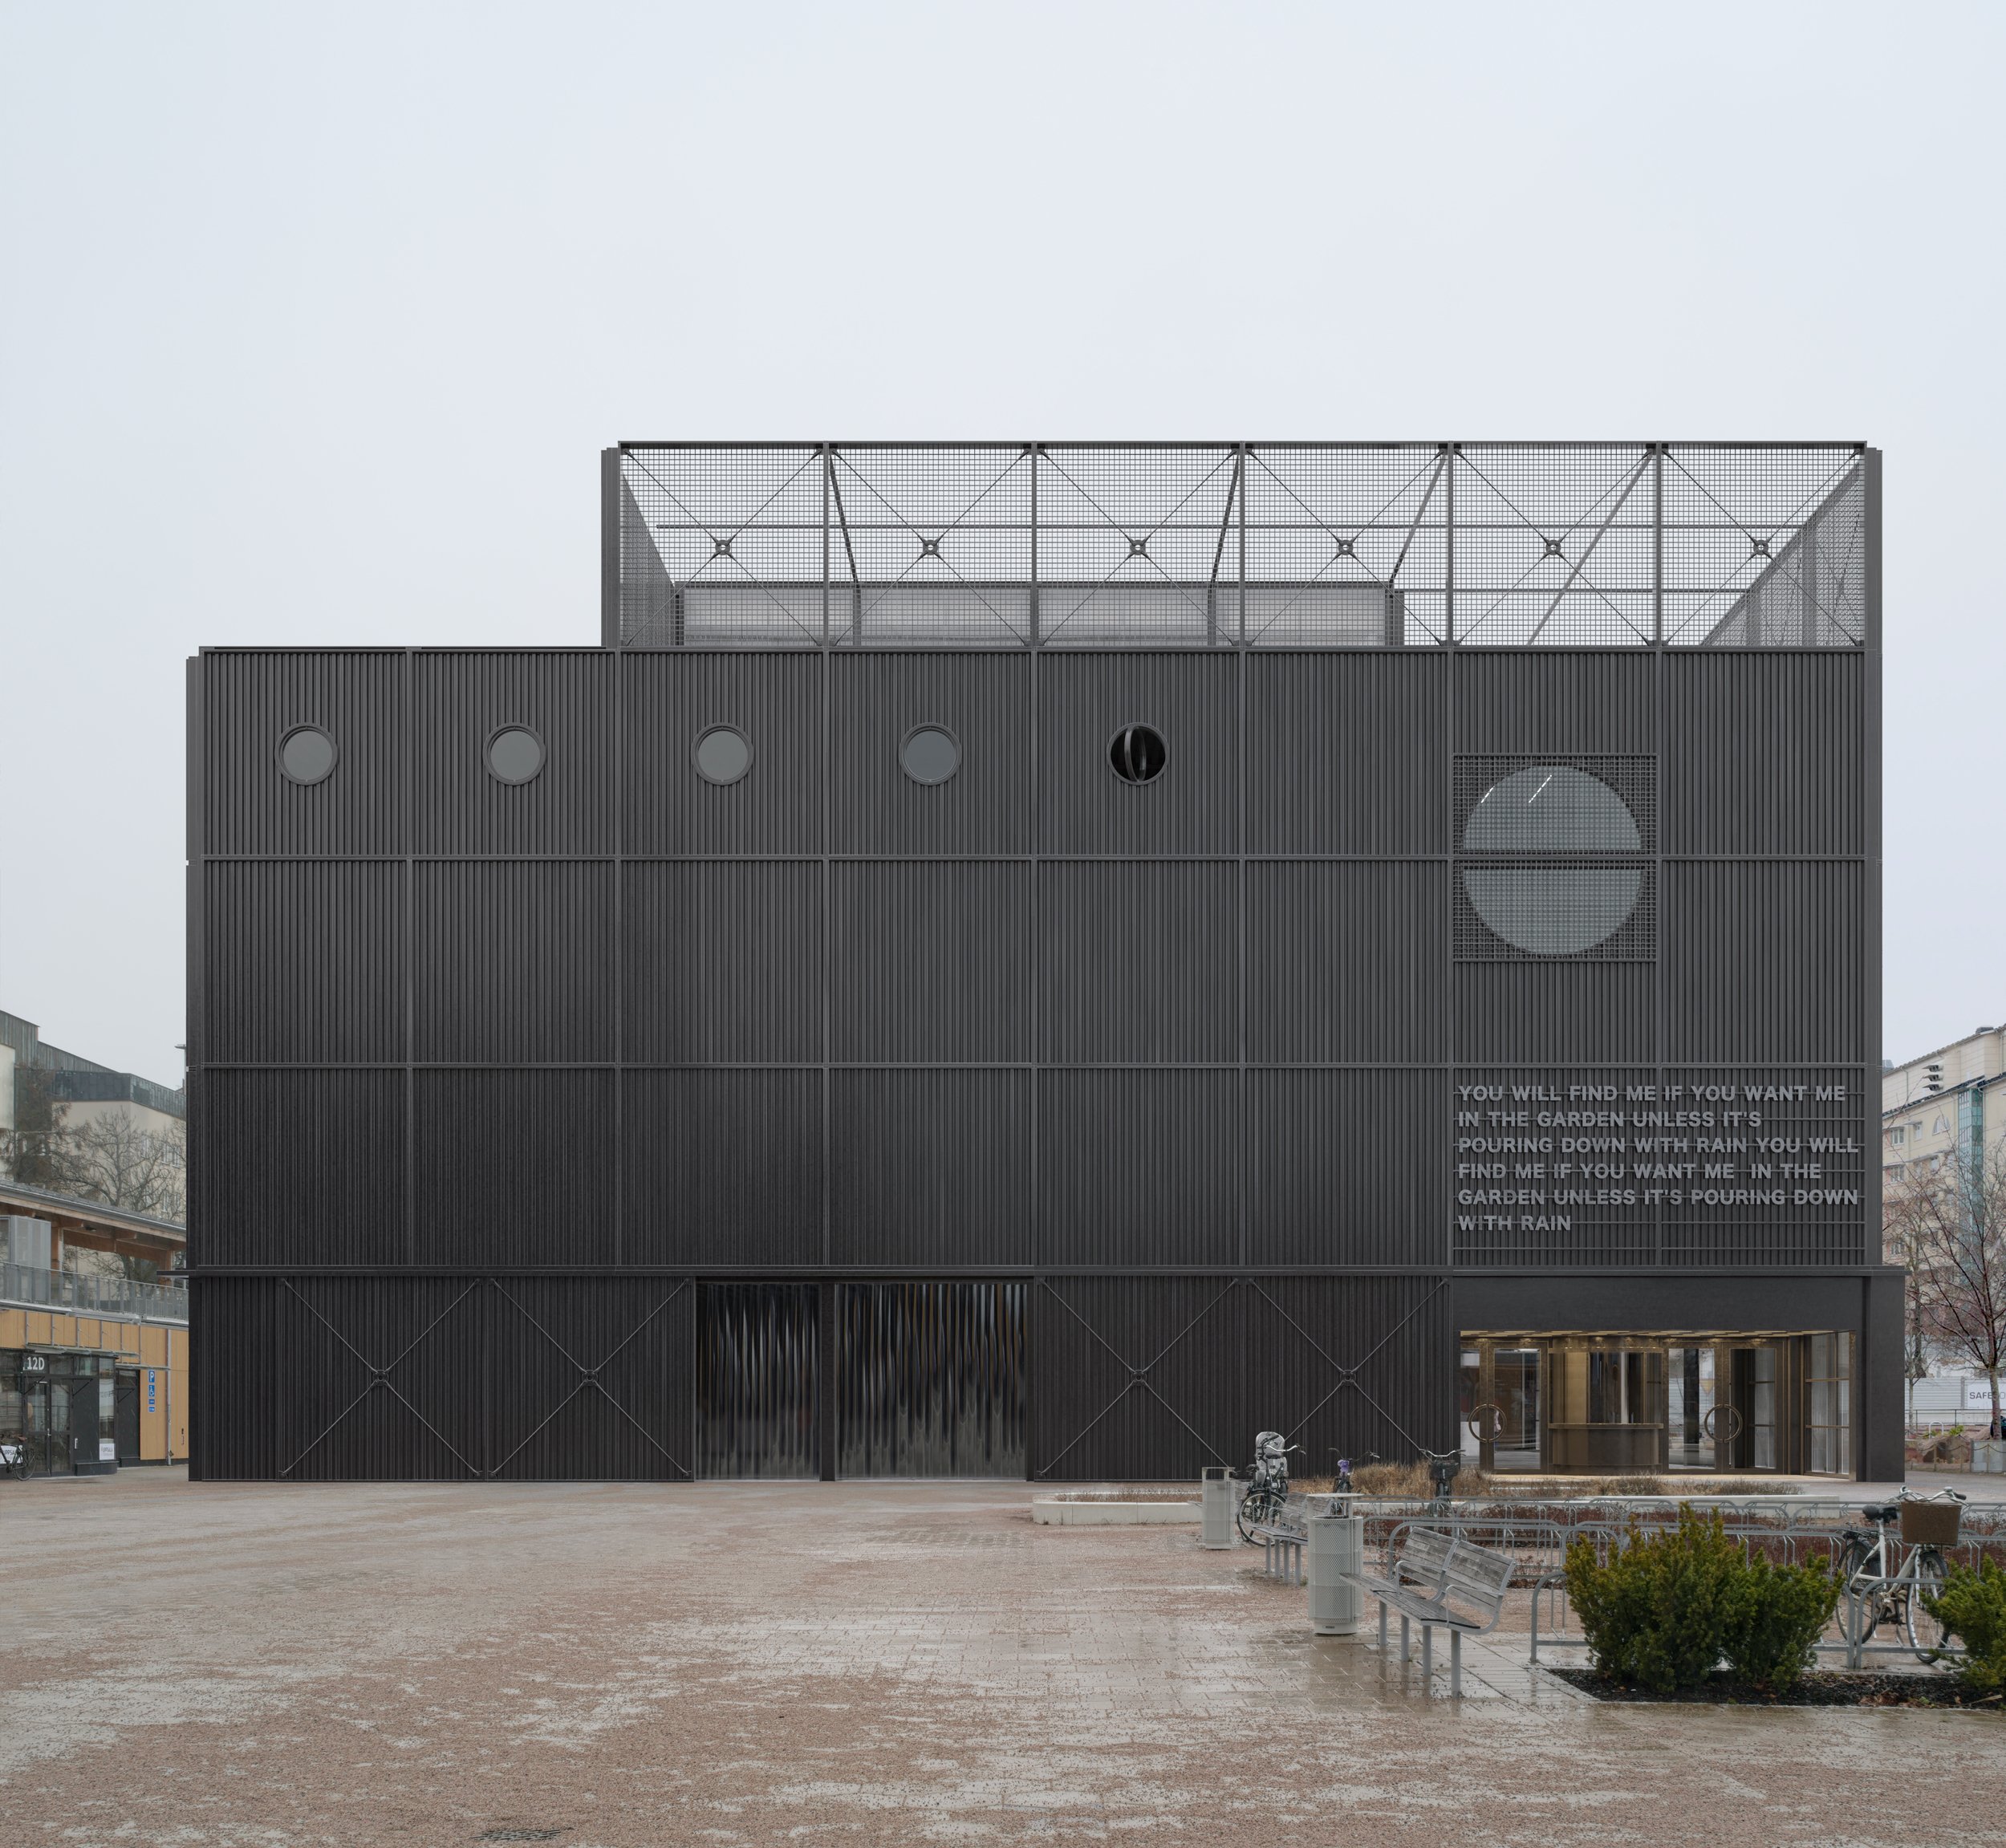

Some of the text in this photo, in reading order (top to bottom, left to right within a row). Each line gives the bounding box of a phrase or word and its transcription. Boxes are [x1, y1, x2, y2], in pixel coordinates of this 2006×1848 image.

[1459, 1086, 1846, 1100] YOU WILL FIND ME IF YOU WANT ME
[1459, 1111, 1761, 1126] IN THE GARDEN UNLESS IT'S
[1459, 1137, 1859, 1152] POURING DOWN WITH RAIN YOU WILL
[1459, 1164, 1821, 1178] FIND ME IF YOU WANT ME IN THE
[1458, 1189, 1858, 1204] GARDEN UNLESS IT'S POURING DOWN
[1458, 1215, 1570, 1230] WITH RAIN
[27, 1356, 45, 1371] 12D
